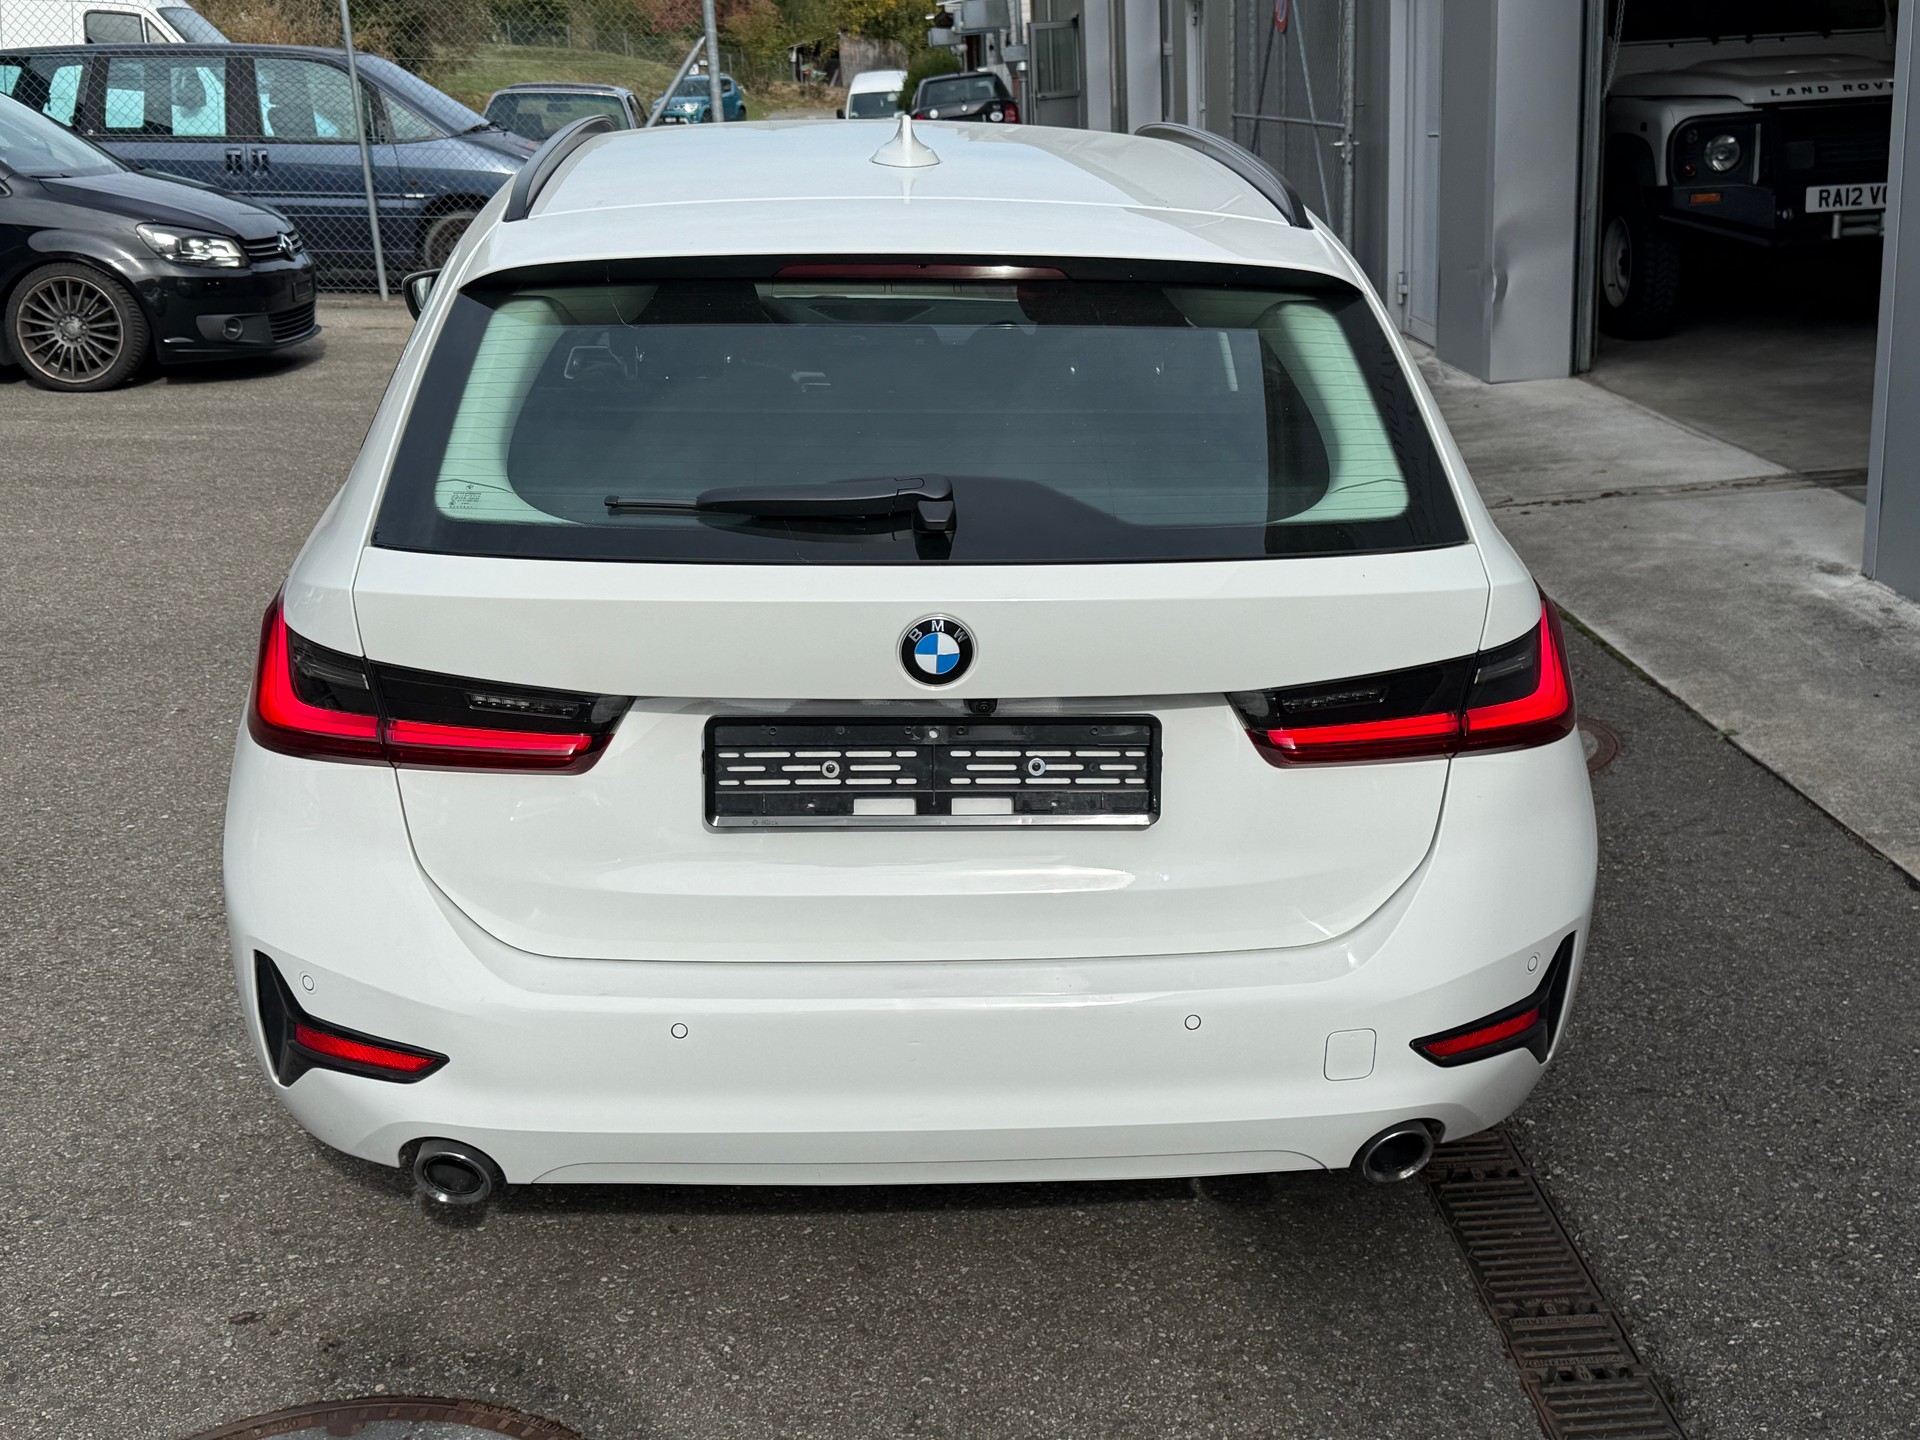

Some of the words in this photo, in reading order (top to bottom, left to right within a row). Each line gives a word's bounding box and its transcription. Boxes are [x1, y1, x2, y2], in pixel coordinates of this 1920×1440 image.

[1770, 85, 1830, 97] LAND
[1818, 187, 1863, 208] RA12
[908, 620, 969, 643] BMW
